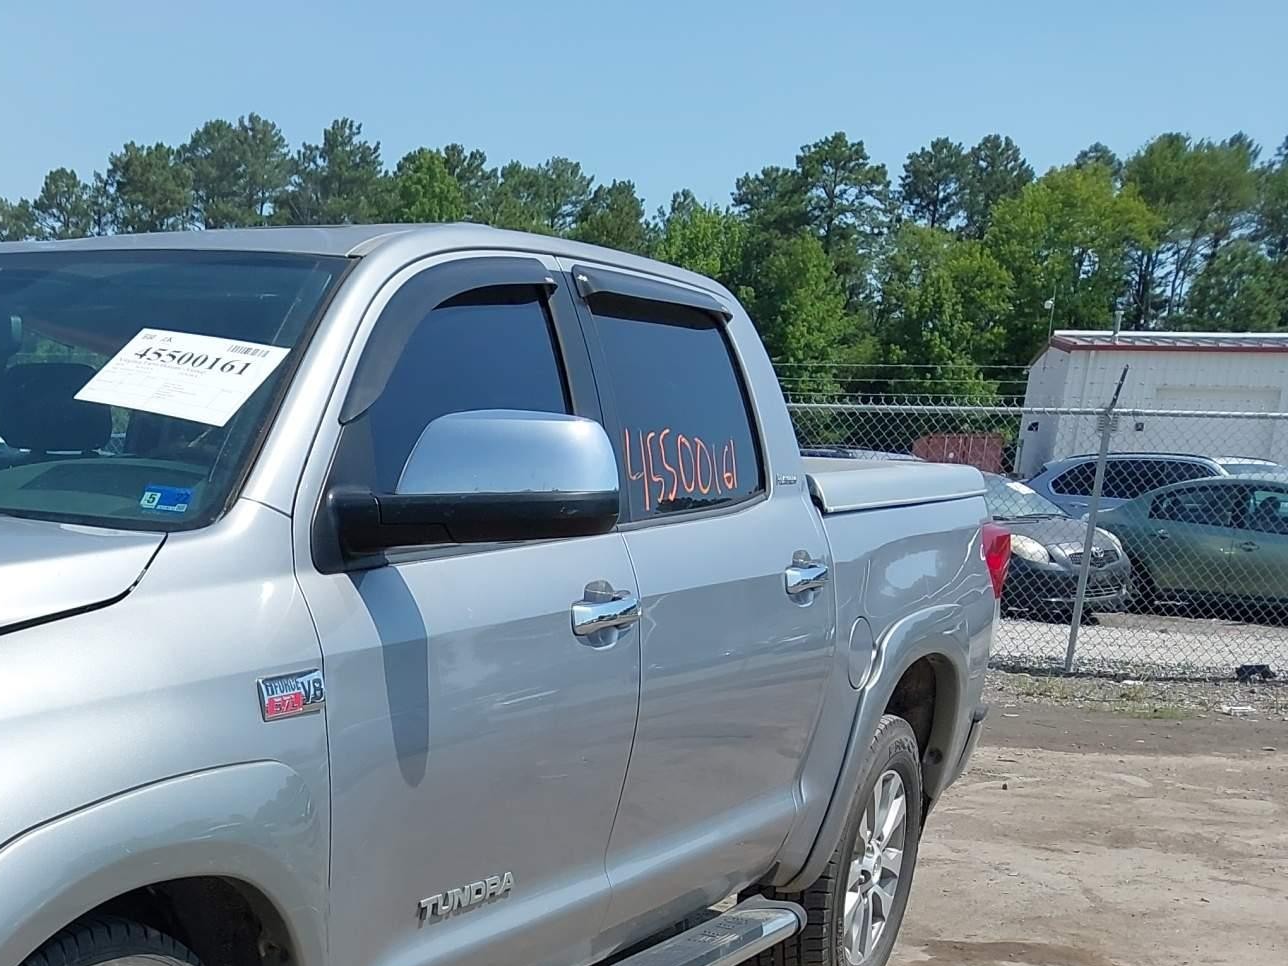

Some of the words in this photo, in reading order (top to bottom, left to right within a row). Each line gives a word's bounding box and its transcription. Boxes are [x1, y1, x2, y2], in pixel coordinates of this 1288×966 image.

[134, 346, 253, 375] 45500161
[624, 428, 738, 511] 45500161
[301, 677, 324, 704] V8
[418, 871, 515, 922] TUNDRA
